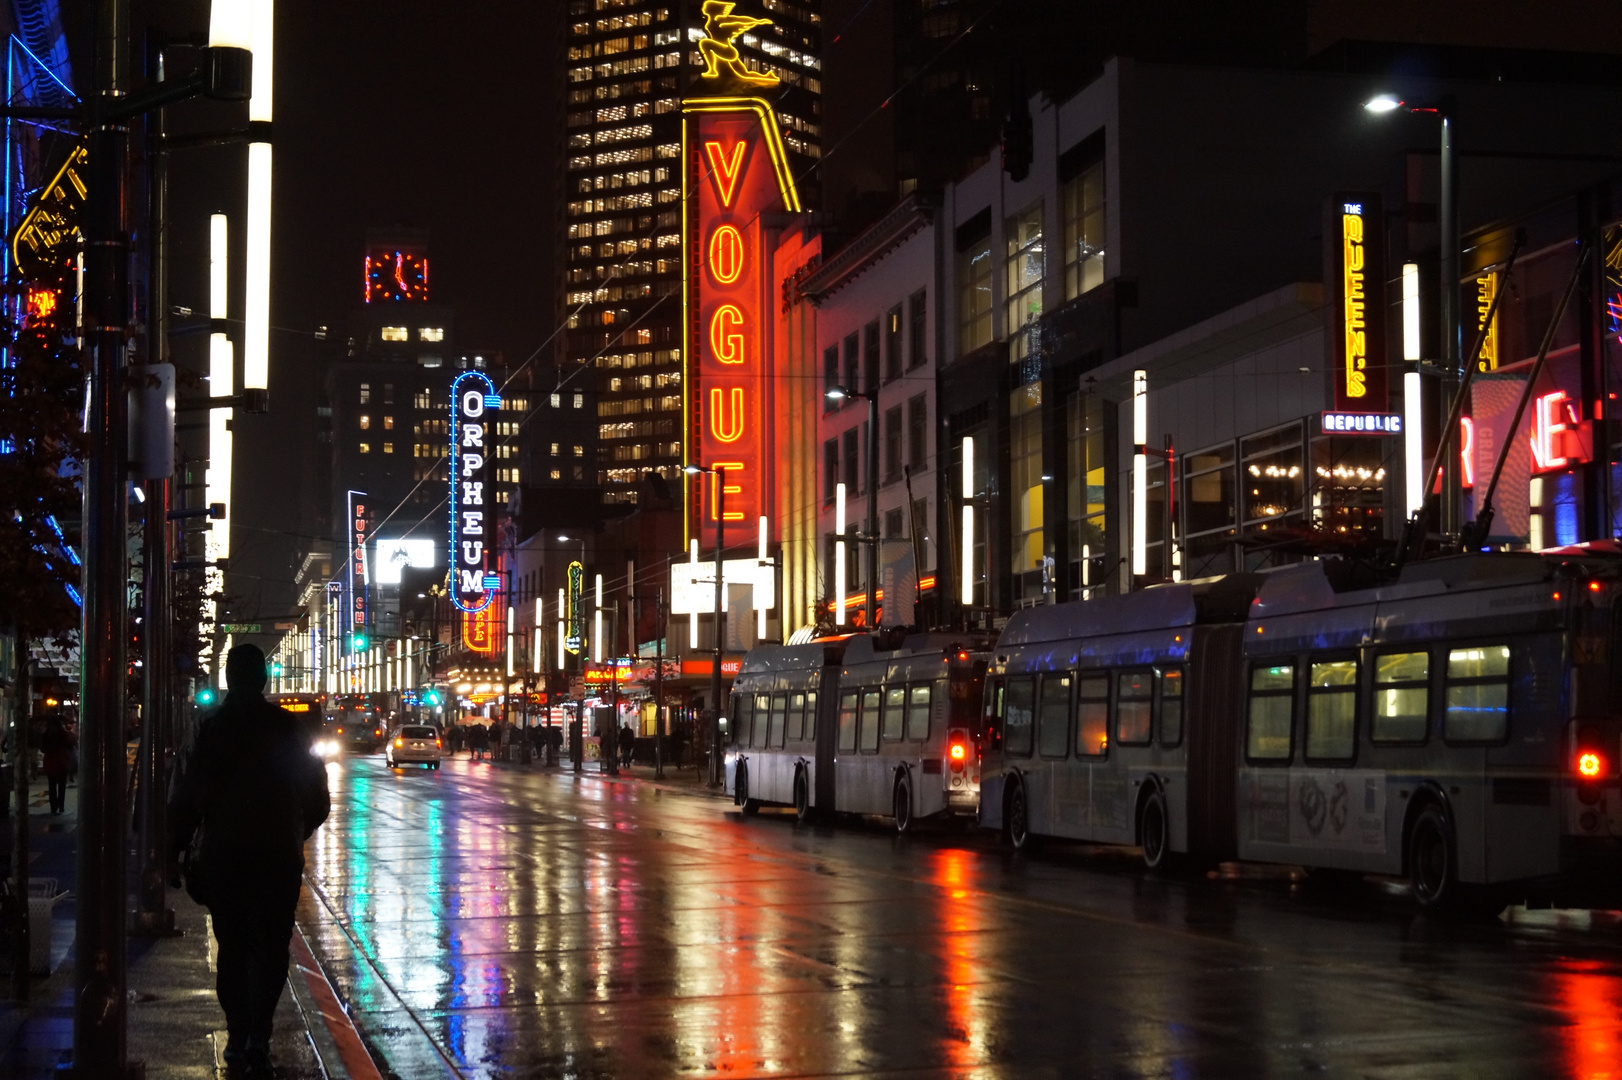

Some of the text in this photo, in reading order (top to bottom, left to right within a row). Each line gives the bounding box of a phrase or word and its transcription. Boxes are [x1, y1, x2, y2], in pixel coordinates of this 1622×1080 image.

[1342, 203, 1362, 215] THE
[704, 140, 748, 522] VOGUE
[1341, 214, 1367, 399] QUEEN'S
[461, 389, 484, 594] ORPHEUM
[1324, 414, 1400, 432] REPUBLIC
